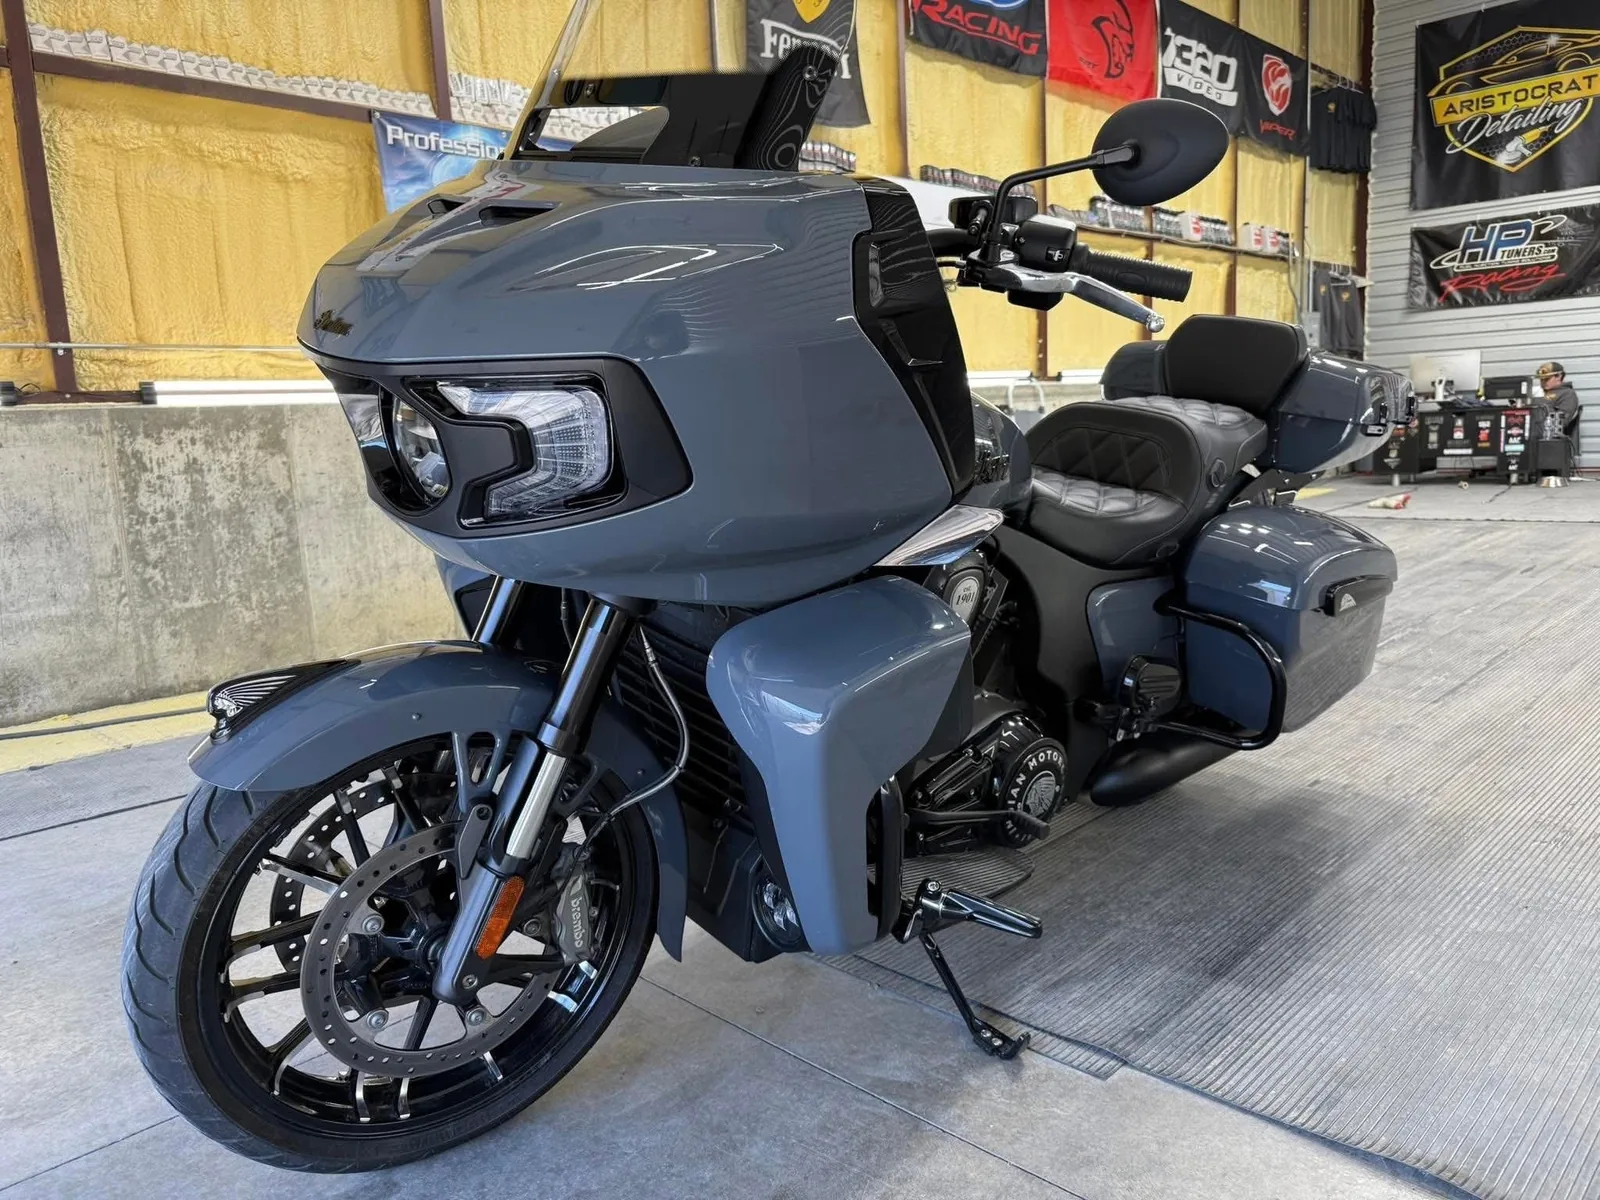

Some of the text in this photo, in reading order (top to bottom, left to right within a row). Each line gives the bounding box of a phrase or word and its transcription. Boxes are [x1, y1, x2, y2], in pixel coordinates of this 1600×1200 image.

[912, 0, 1043, 56] RACING
[1162, 27, 1238, 91] 1320
[1176, 73, 1223, 101] VIDEO
[1443, 73, 1599, 117] ARISTOCRAT
[1445, 95, 1584, 154] Detailing
[1457, 219, 1535, 265] HP
[1437, 263, 1566, 304] Racing
[956, 592, 976, 606] 1901
[570, 897, 584, 948] brembo
